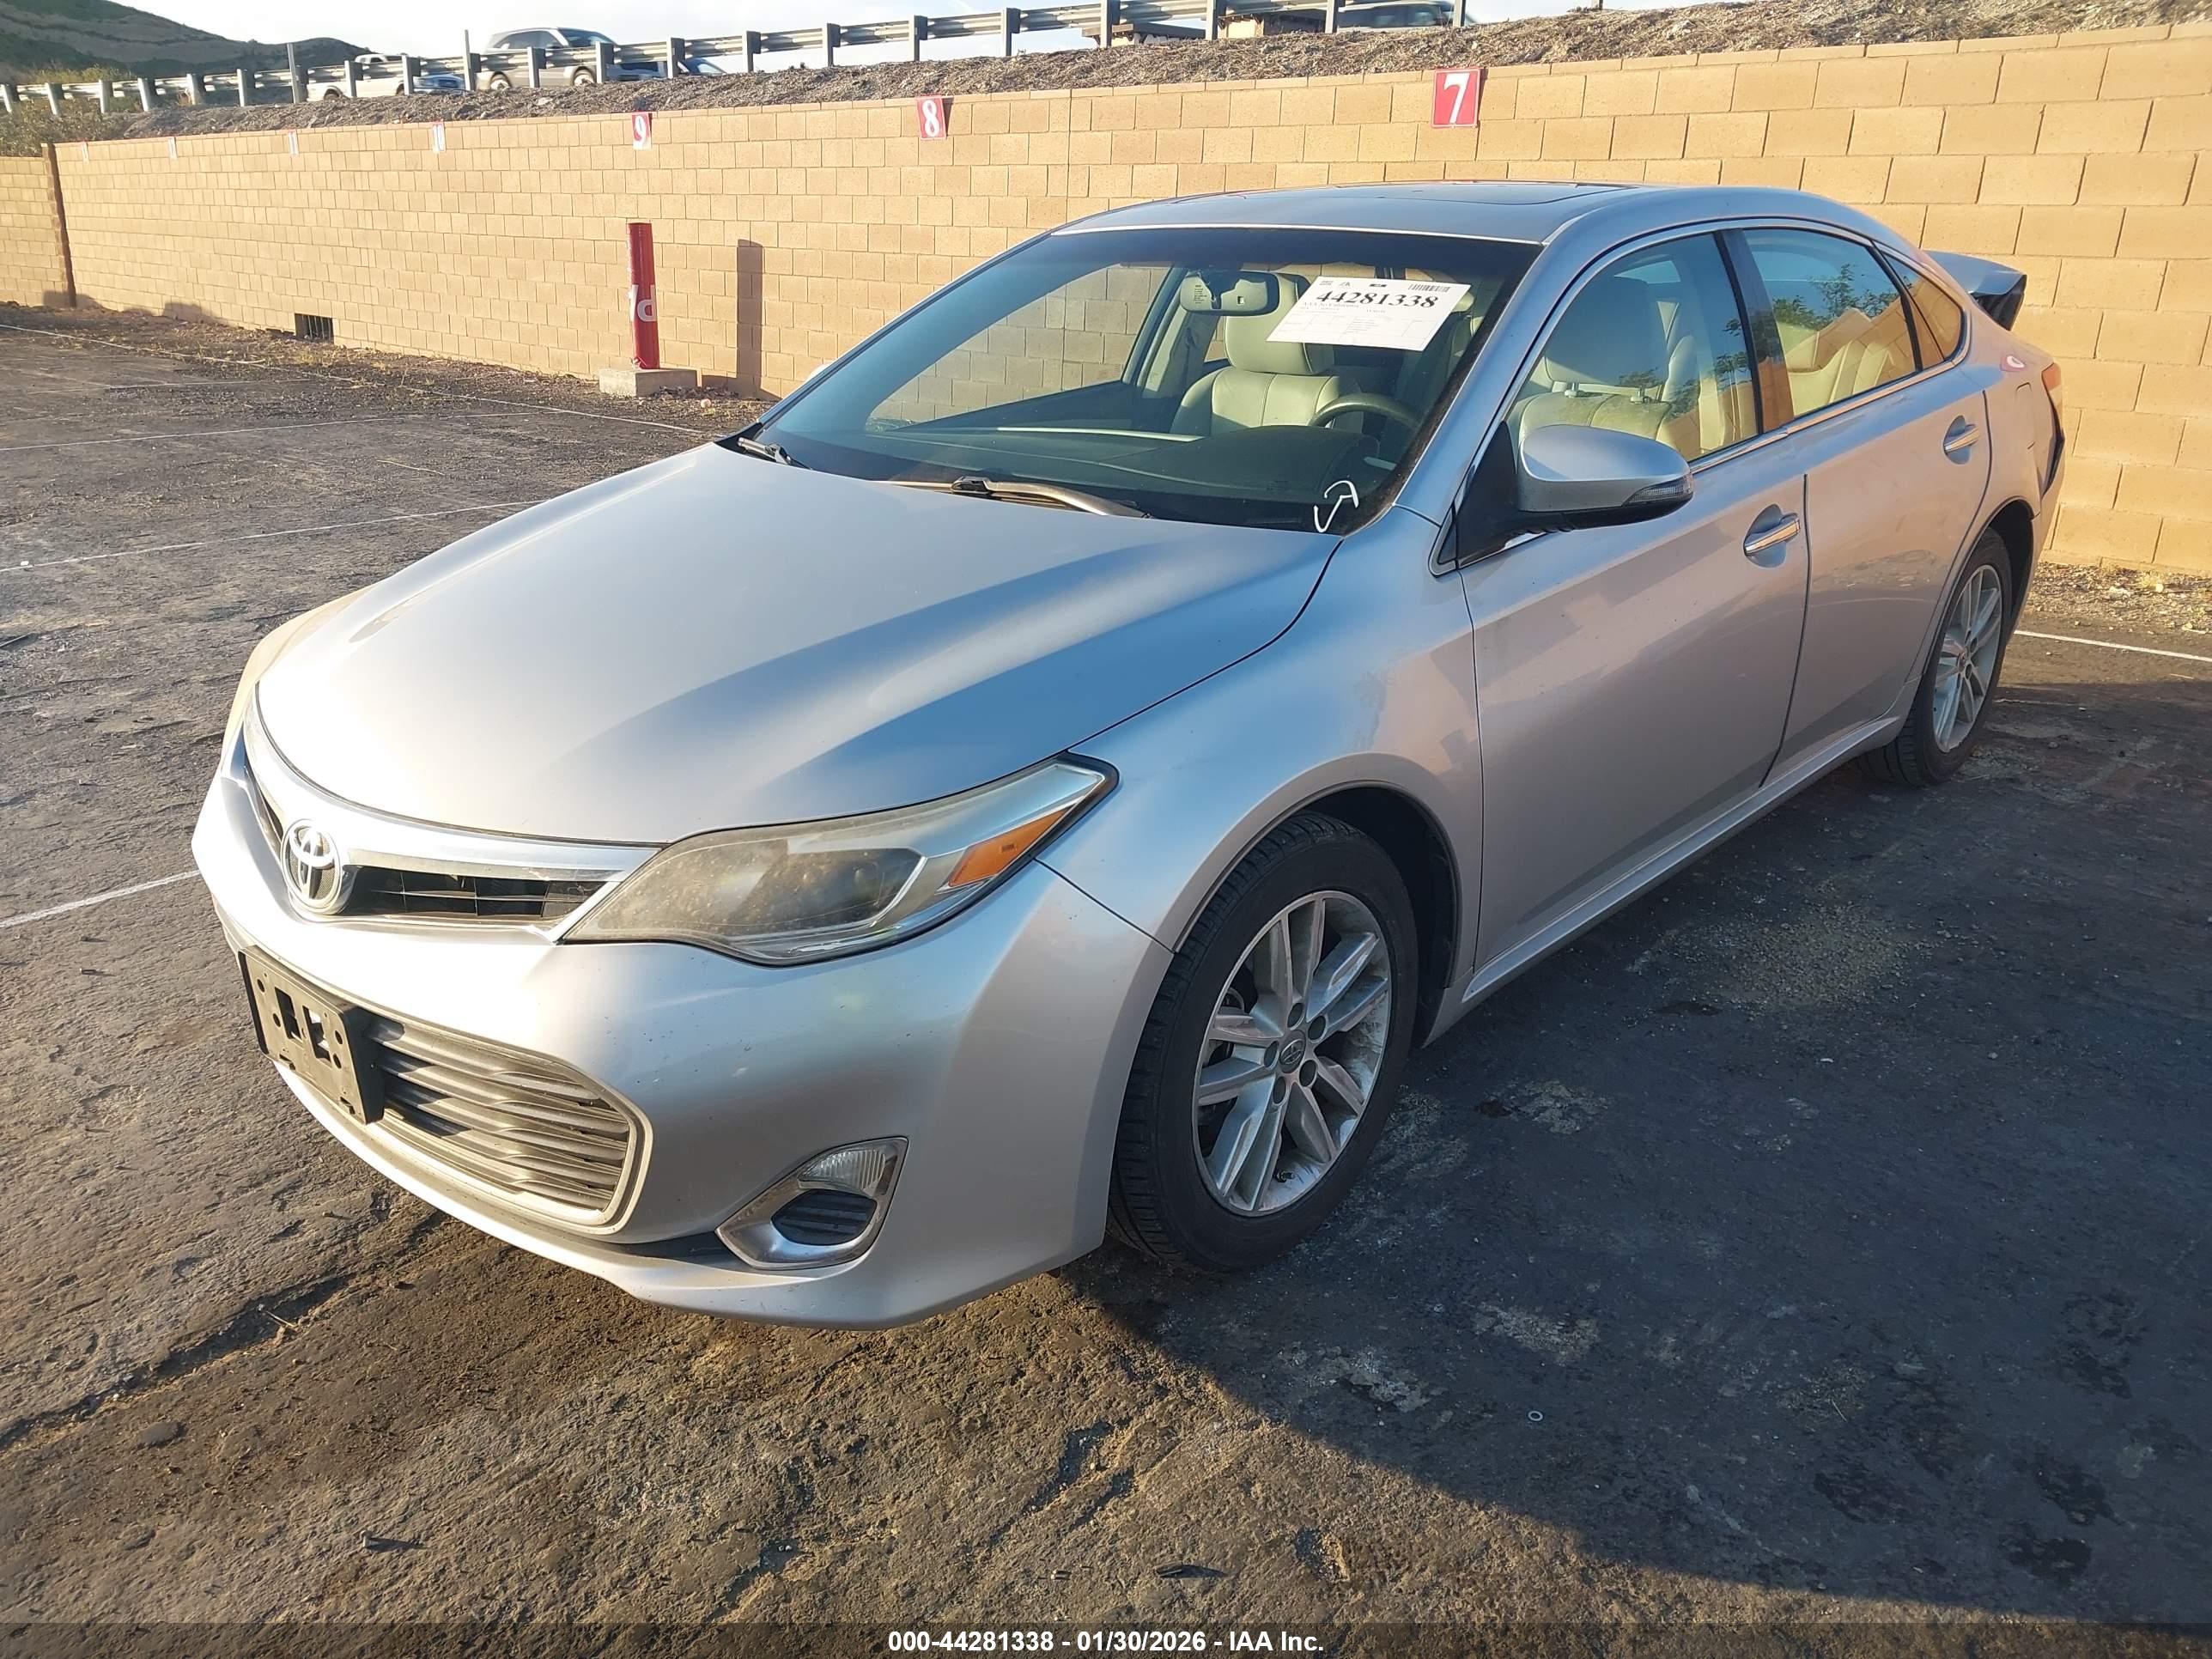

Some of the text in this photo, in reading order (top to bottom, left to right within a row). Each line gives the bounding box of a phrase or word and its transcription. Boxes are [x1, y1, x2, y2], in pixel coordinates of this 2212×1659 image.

[1443, 72, 1471, 125] 7
[634, 115, 647, 148] 9
[922, 100, 940, 137] 8
[1316, 290, 1439, 309] 44281338
